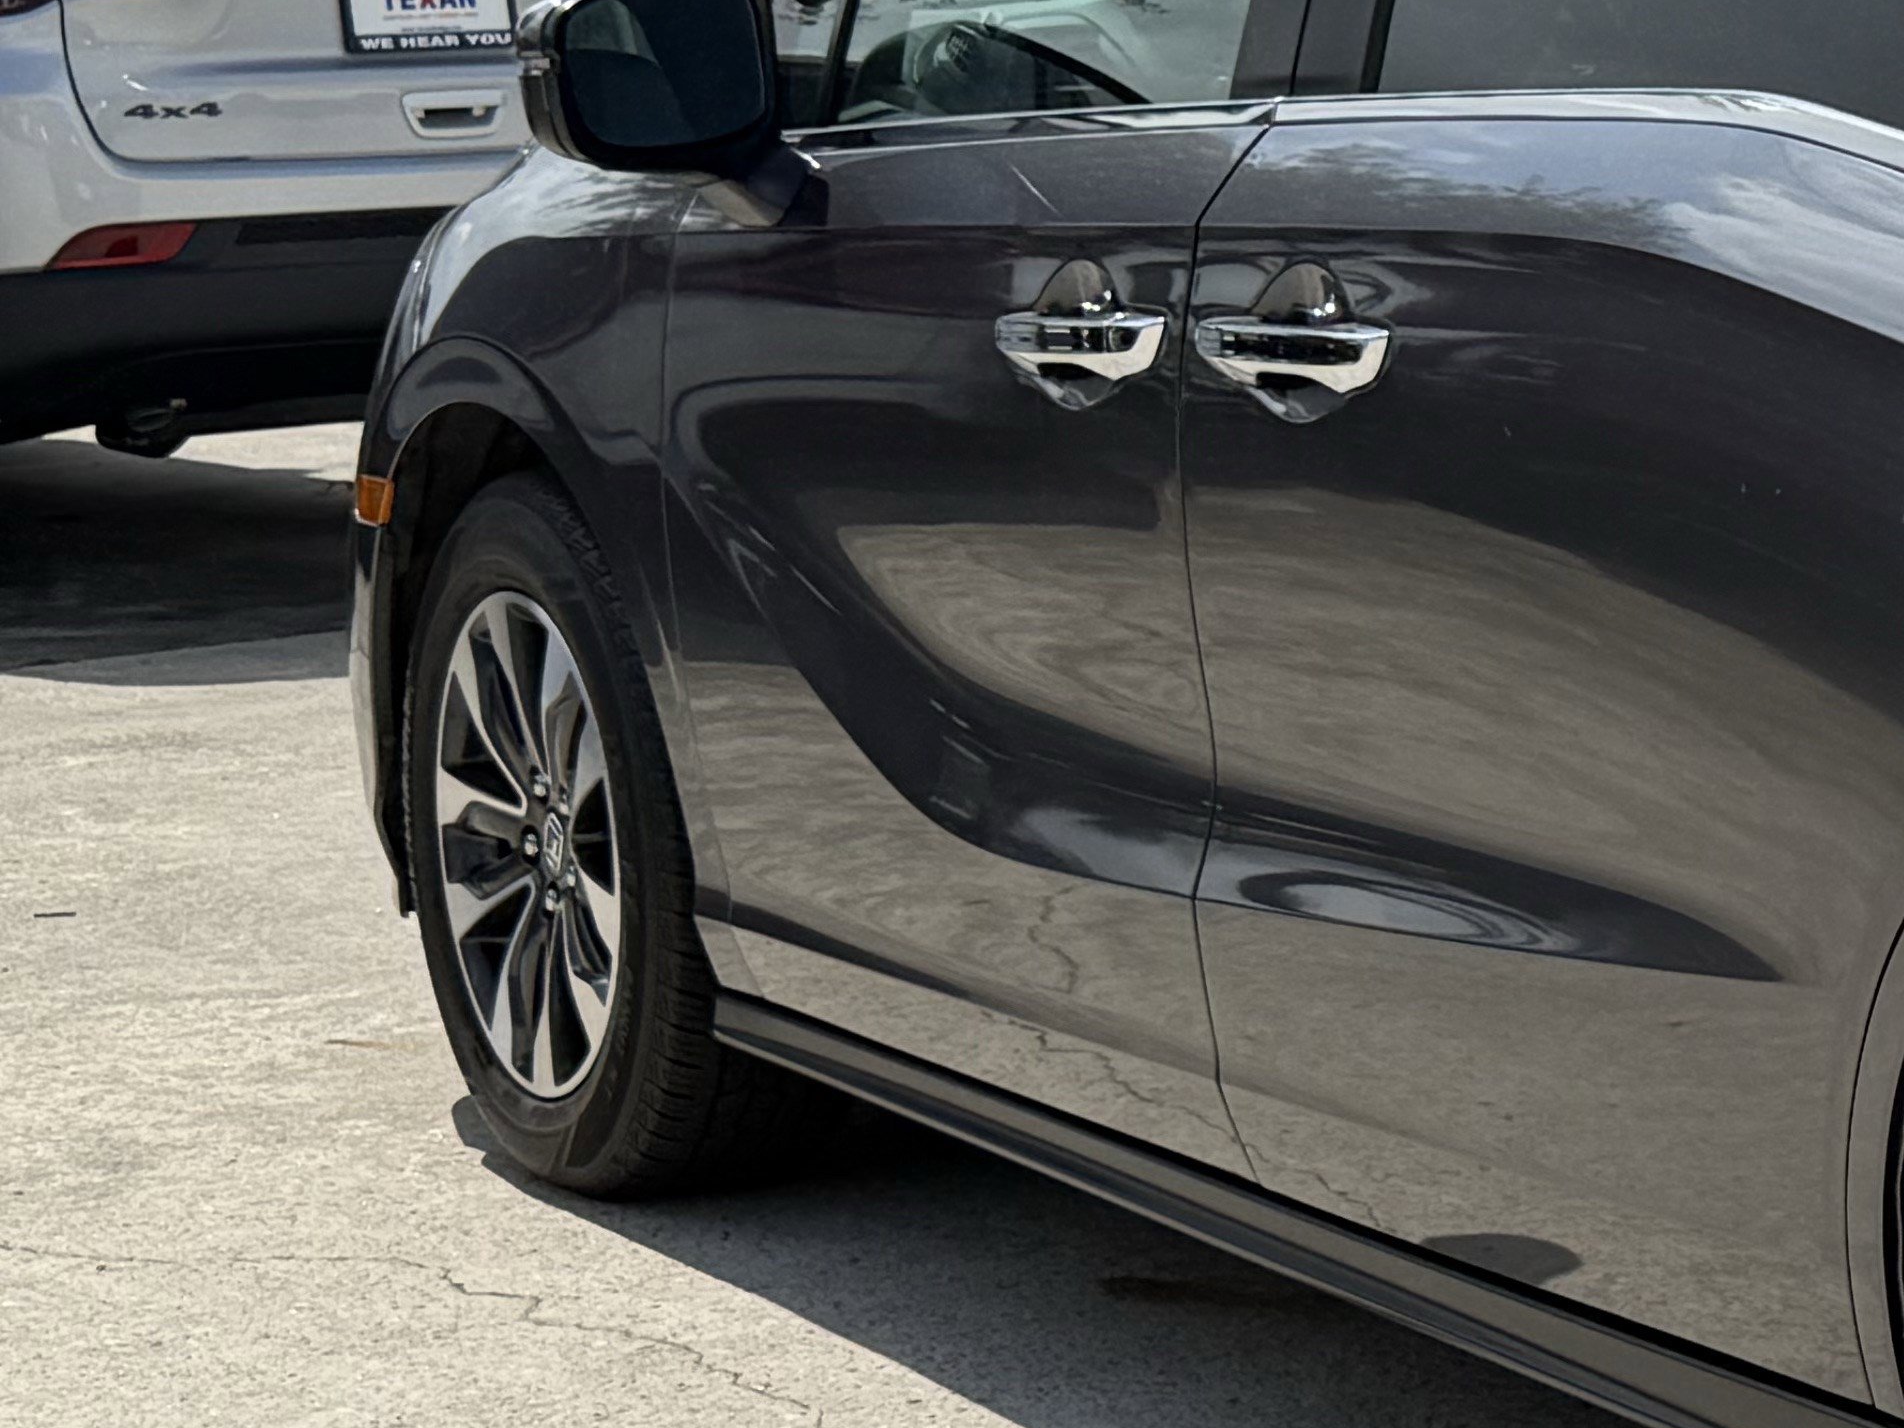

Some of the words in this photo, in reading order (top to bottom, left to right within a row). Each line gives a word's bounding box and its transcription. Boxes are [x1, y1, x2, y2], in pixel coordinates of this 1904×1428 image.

[360, 37, 394, 50] WE
[401, 33, 460, 49] HEAR
[464, 32, 512, 46] YOU
[124, 102, 223, 119] 4x4
